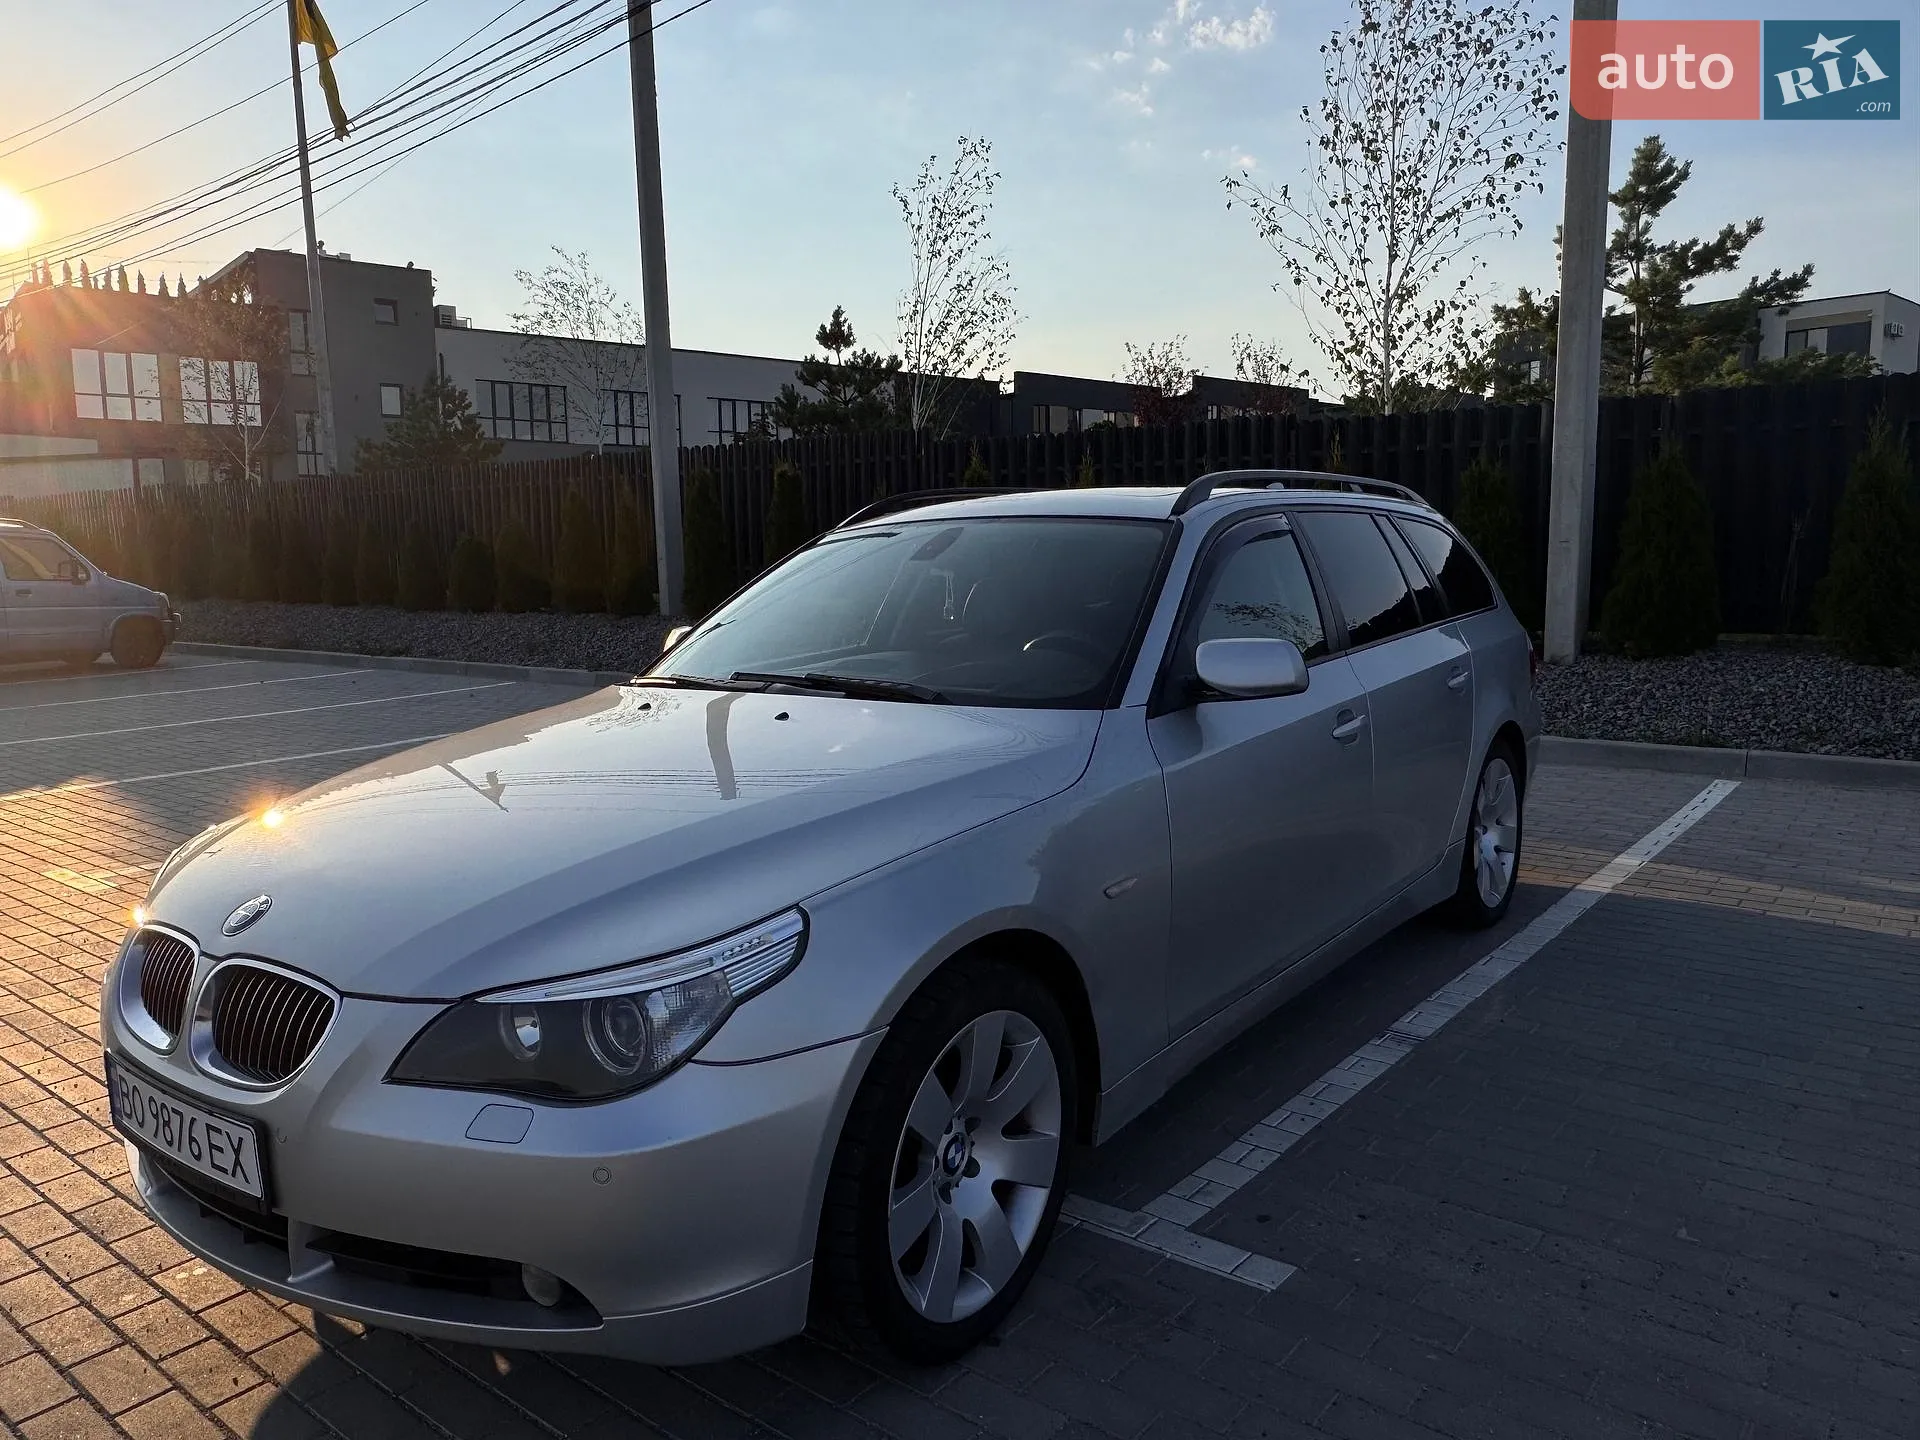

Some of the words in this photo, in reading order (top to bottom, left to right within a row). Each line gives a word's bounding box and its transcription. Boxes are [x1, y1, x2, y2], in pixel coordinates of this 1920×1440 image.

[118, 1074, 145, 1129] BO
[148, 1095, 202, 1162] 9876
[205, 1123, 251, 1185] EX
